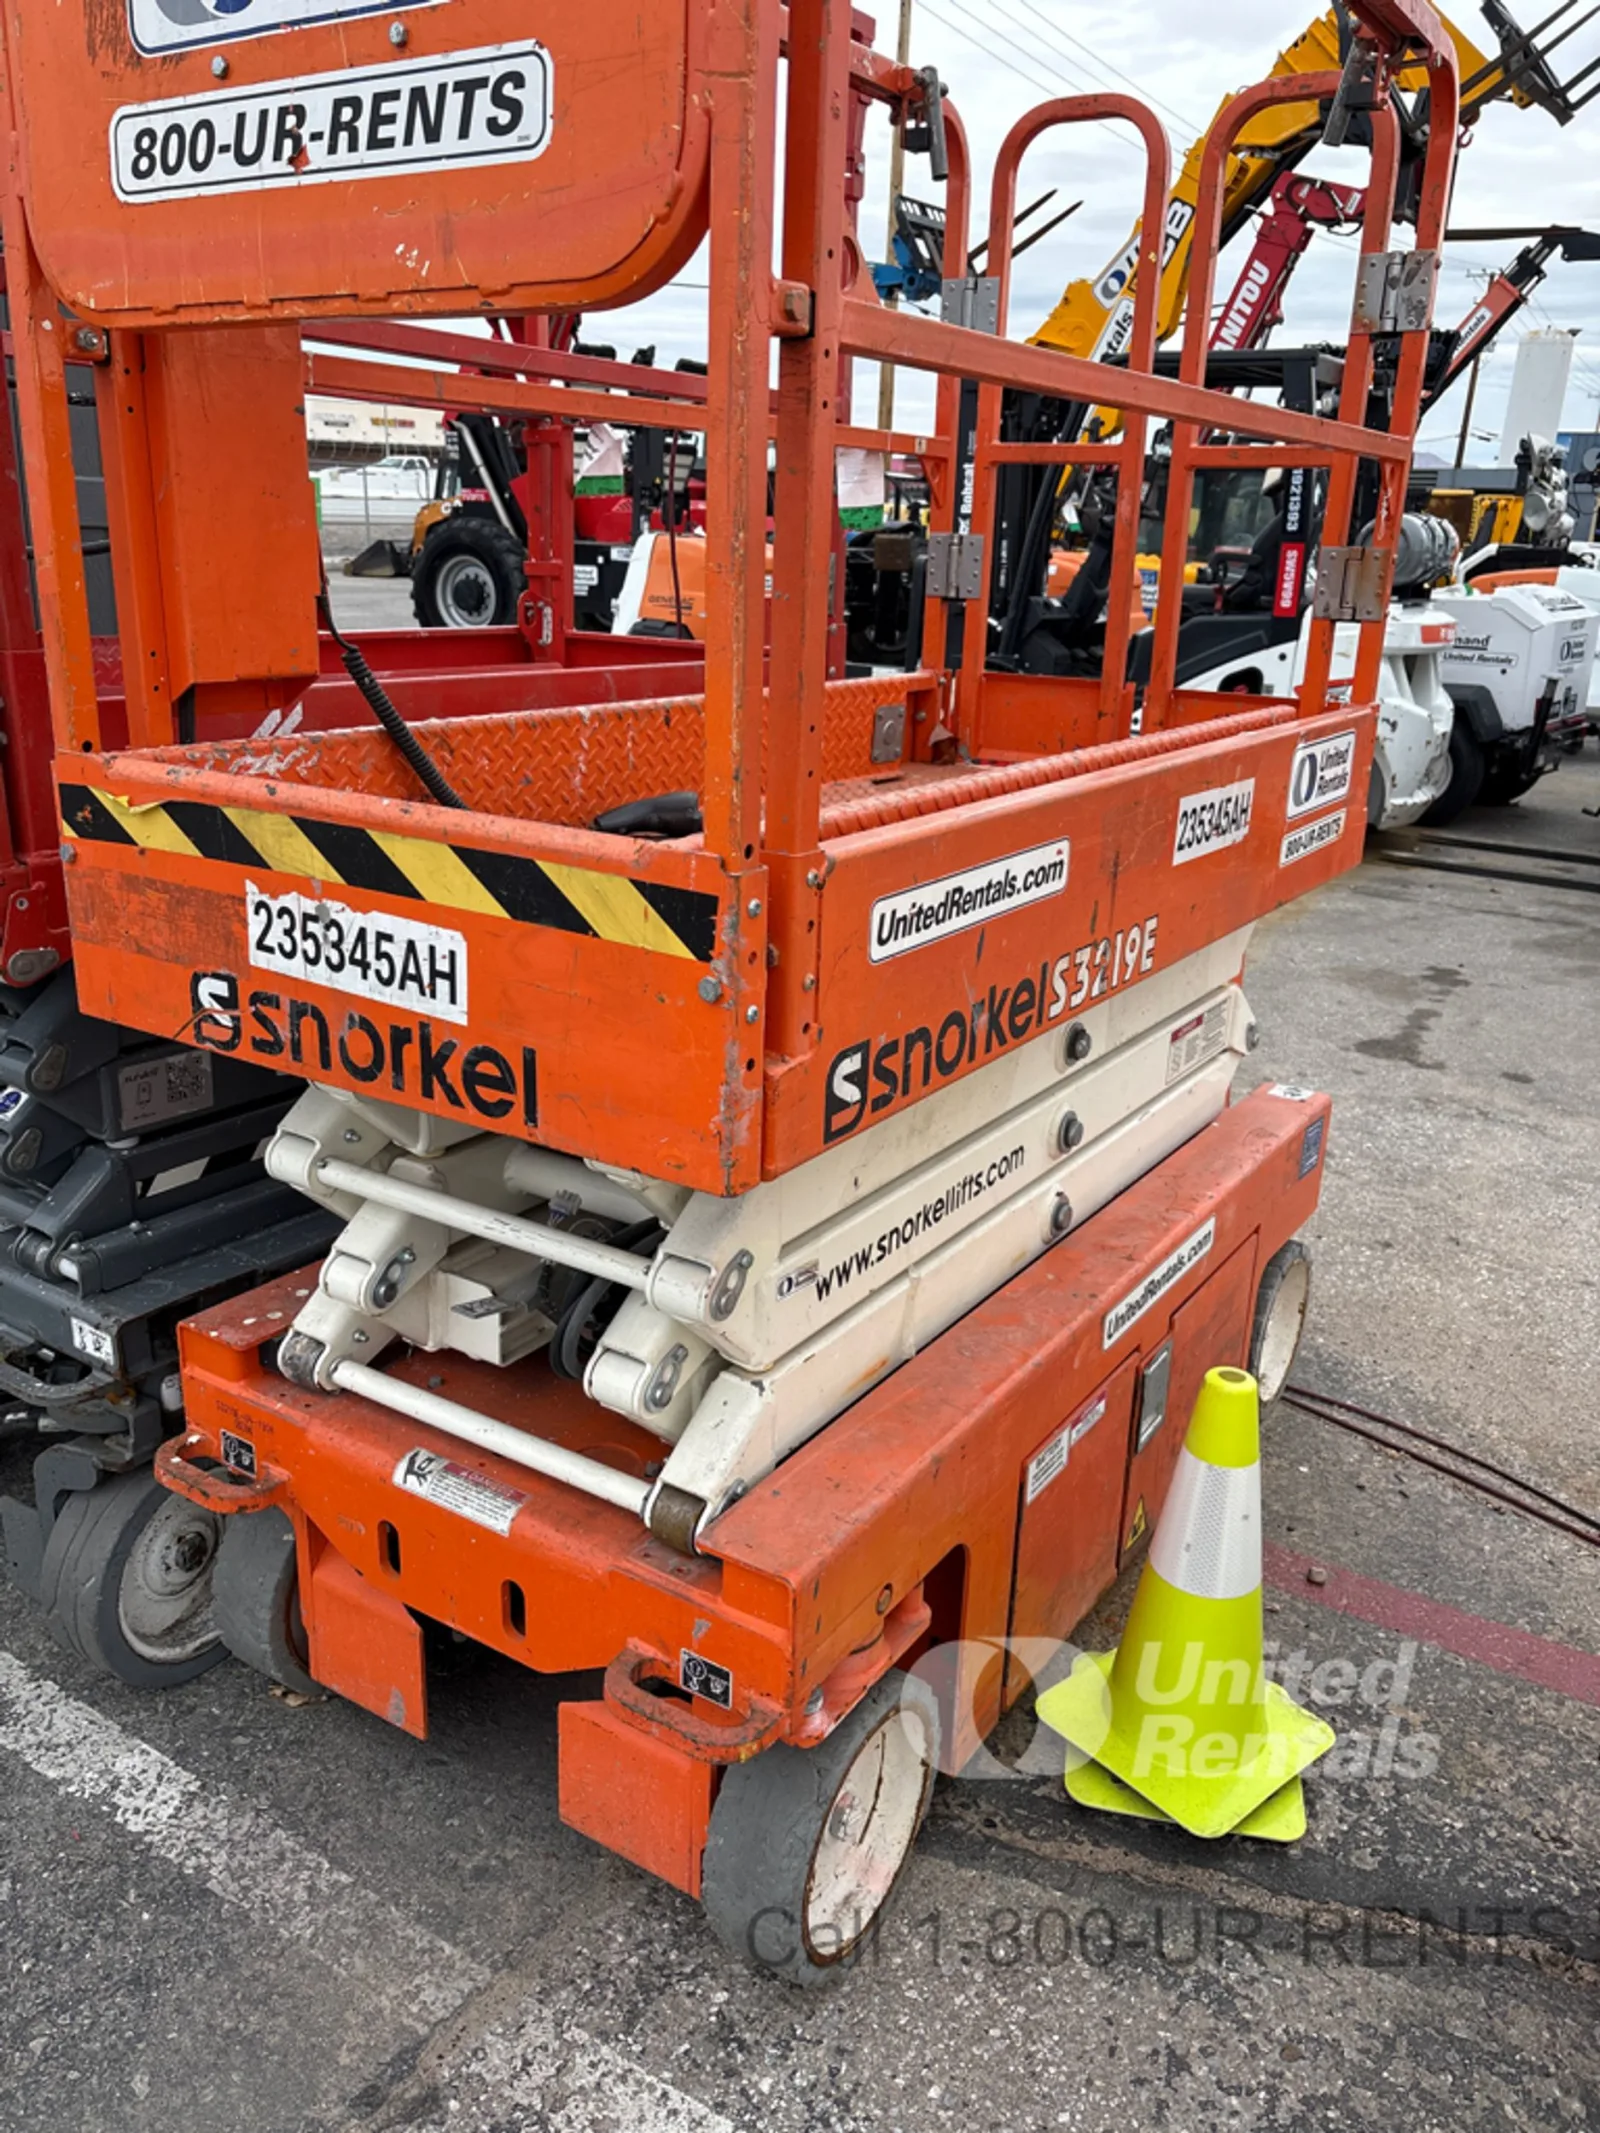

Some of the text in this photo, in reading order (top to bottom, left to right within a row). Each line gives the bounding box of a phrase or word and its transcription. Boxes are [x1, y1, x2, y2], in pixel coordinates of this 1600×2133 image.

[131, 70, 527, 181] 800-UR-RENTS
[1317, 769, 1349, 797] Rentals
[1319, 741, 1351, 772] United
[1177, 791, 1251, 852] 235345AH
[253, 900, 458, 1005] 235345AH
[876, 857, 1065, 948] UnitedRentals.com
[1048, 914, 1160, 1022] S3219E
[248, 990, 538, 1128] snorkel
[814, 1145, 1026, 1302] www.snorkellifts.com
